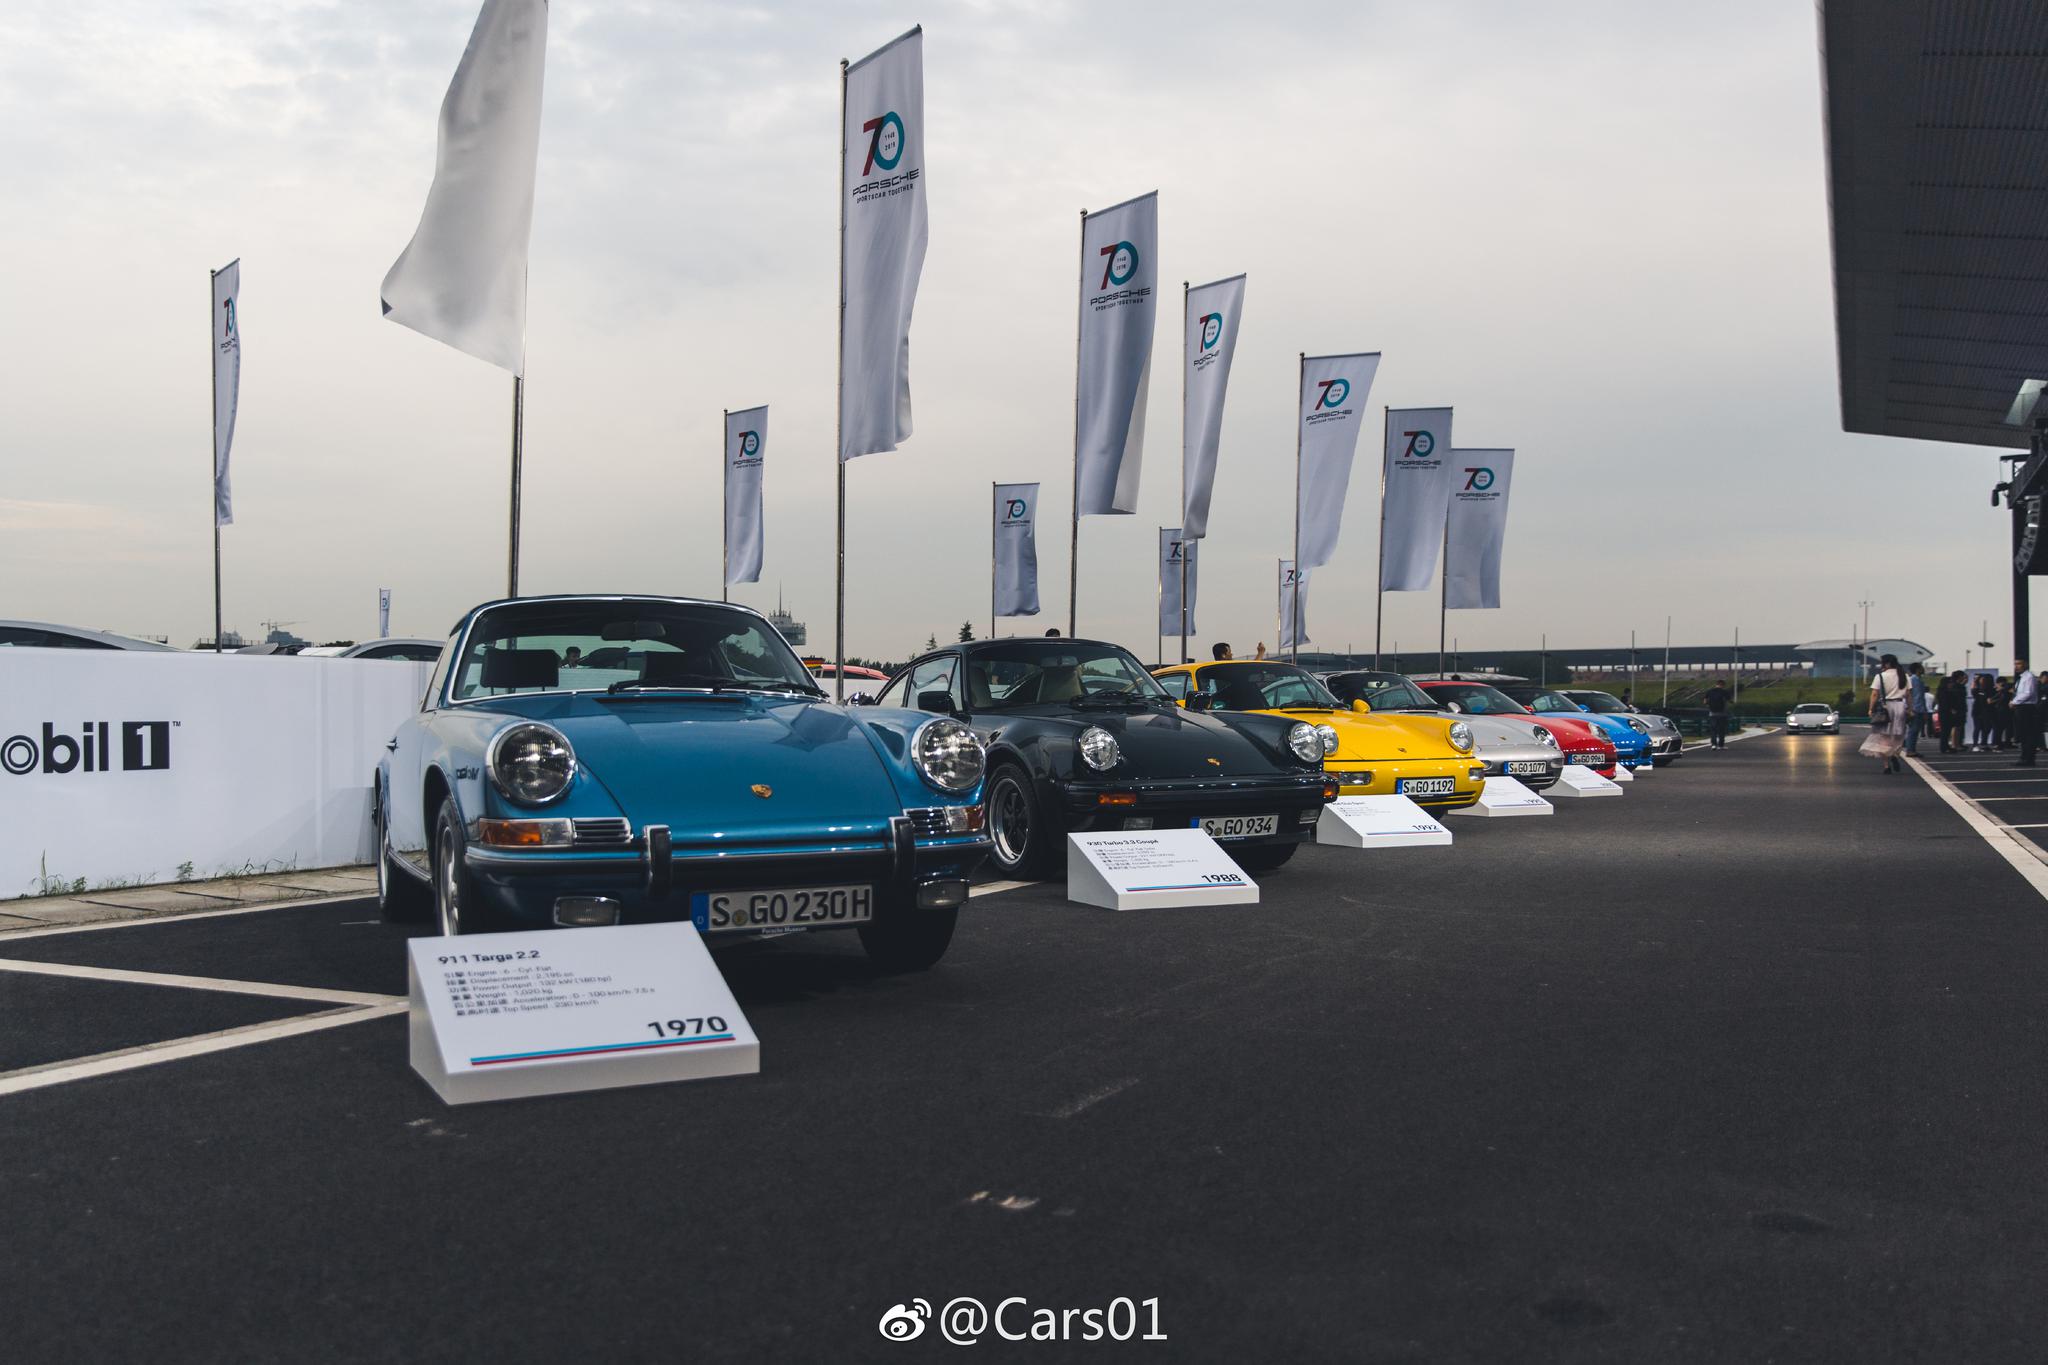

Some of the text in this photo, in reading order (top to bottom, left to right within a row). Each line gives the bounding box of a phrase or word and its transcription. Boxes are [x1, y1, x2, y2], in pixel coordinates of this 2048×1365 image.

[862, 111, 905, 176] 70
[852, 168, 920, 197] PORSCHE
[1100, 240, 1139, 290] 70
[1090, 287, 1151, 306] PORSCHE
[1199, 312, 1223, 353] 70
[1315, 378, 1350, 411] 70
[738, 430, 760, 458] 70
[1403, 430, 1435, 458] 70
[1464, 467, 1495, 491] 70
[1006, 499, 1026, 519] 70
[1403, 779, 1454, 794] S GO 1192
[1223, 819, 1244, 835] GO
[1246, 816, 1272, 834] 934
[1201, 873, 1242, 883] 1988
[711, 896, 731, 927] S
[750, 893, 789, 924] GO
[438, 950, 541, 965] 911 Targa 2.2
[648, 1015, 729, 1038] 1970
